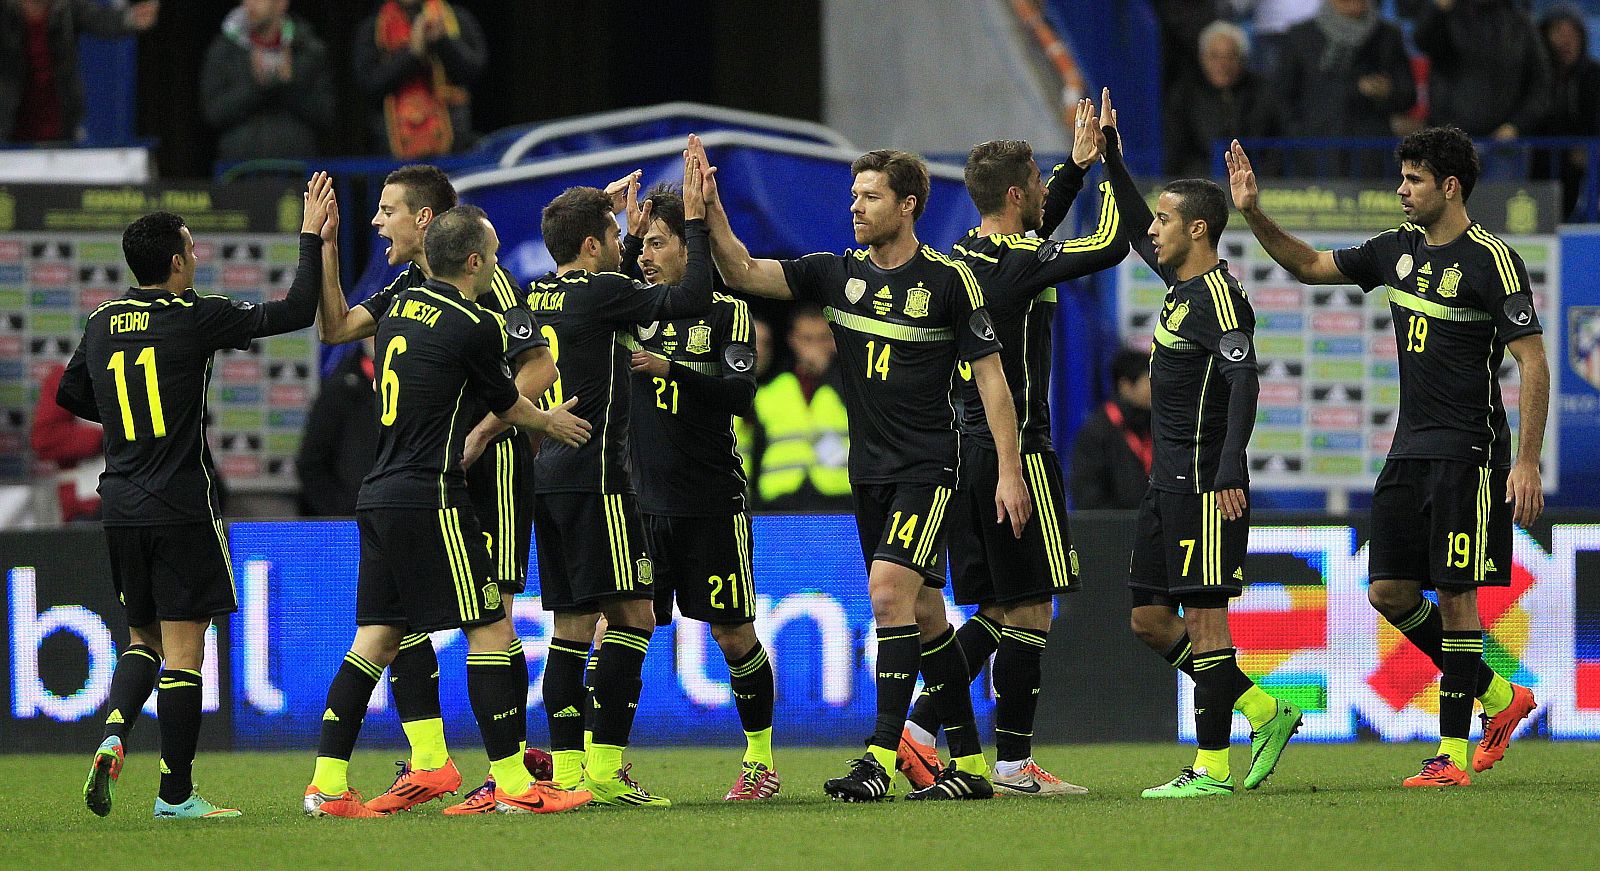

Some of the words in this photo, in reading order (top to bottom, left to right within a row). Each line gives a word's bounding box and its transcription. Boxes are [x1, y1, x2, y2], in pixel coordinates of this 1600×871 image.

[110, 311, 150, 335] PEDRO
[1407, 315, 1428, 353] 19
[866, 340, 891, 381] 14
[107, 346, 167, 441] 11
[380, 335, 408, 427] 6
[652, 376, 679, 414] 21
[886, 511, 919, 549] 14
[1179, 539, 1196, 577] 7
[1446, 531, 1470, 569] 19
[707, 573, 739, 610] 21
[879, 672, 910, 680] RFEF
